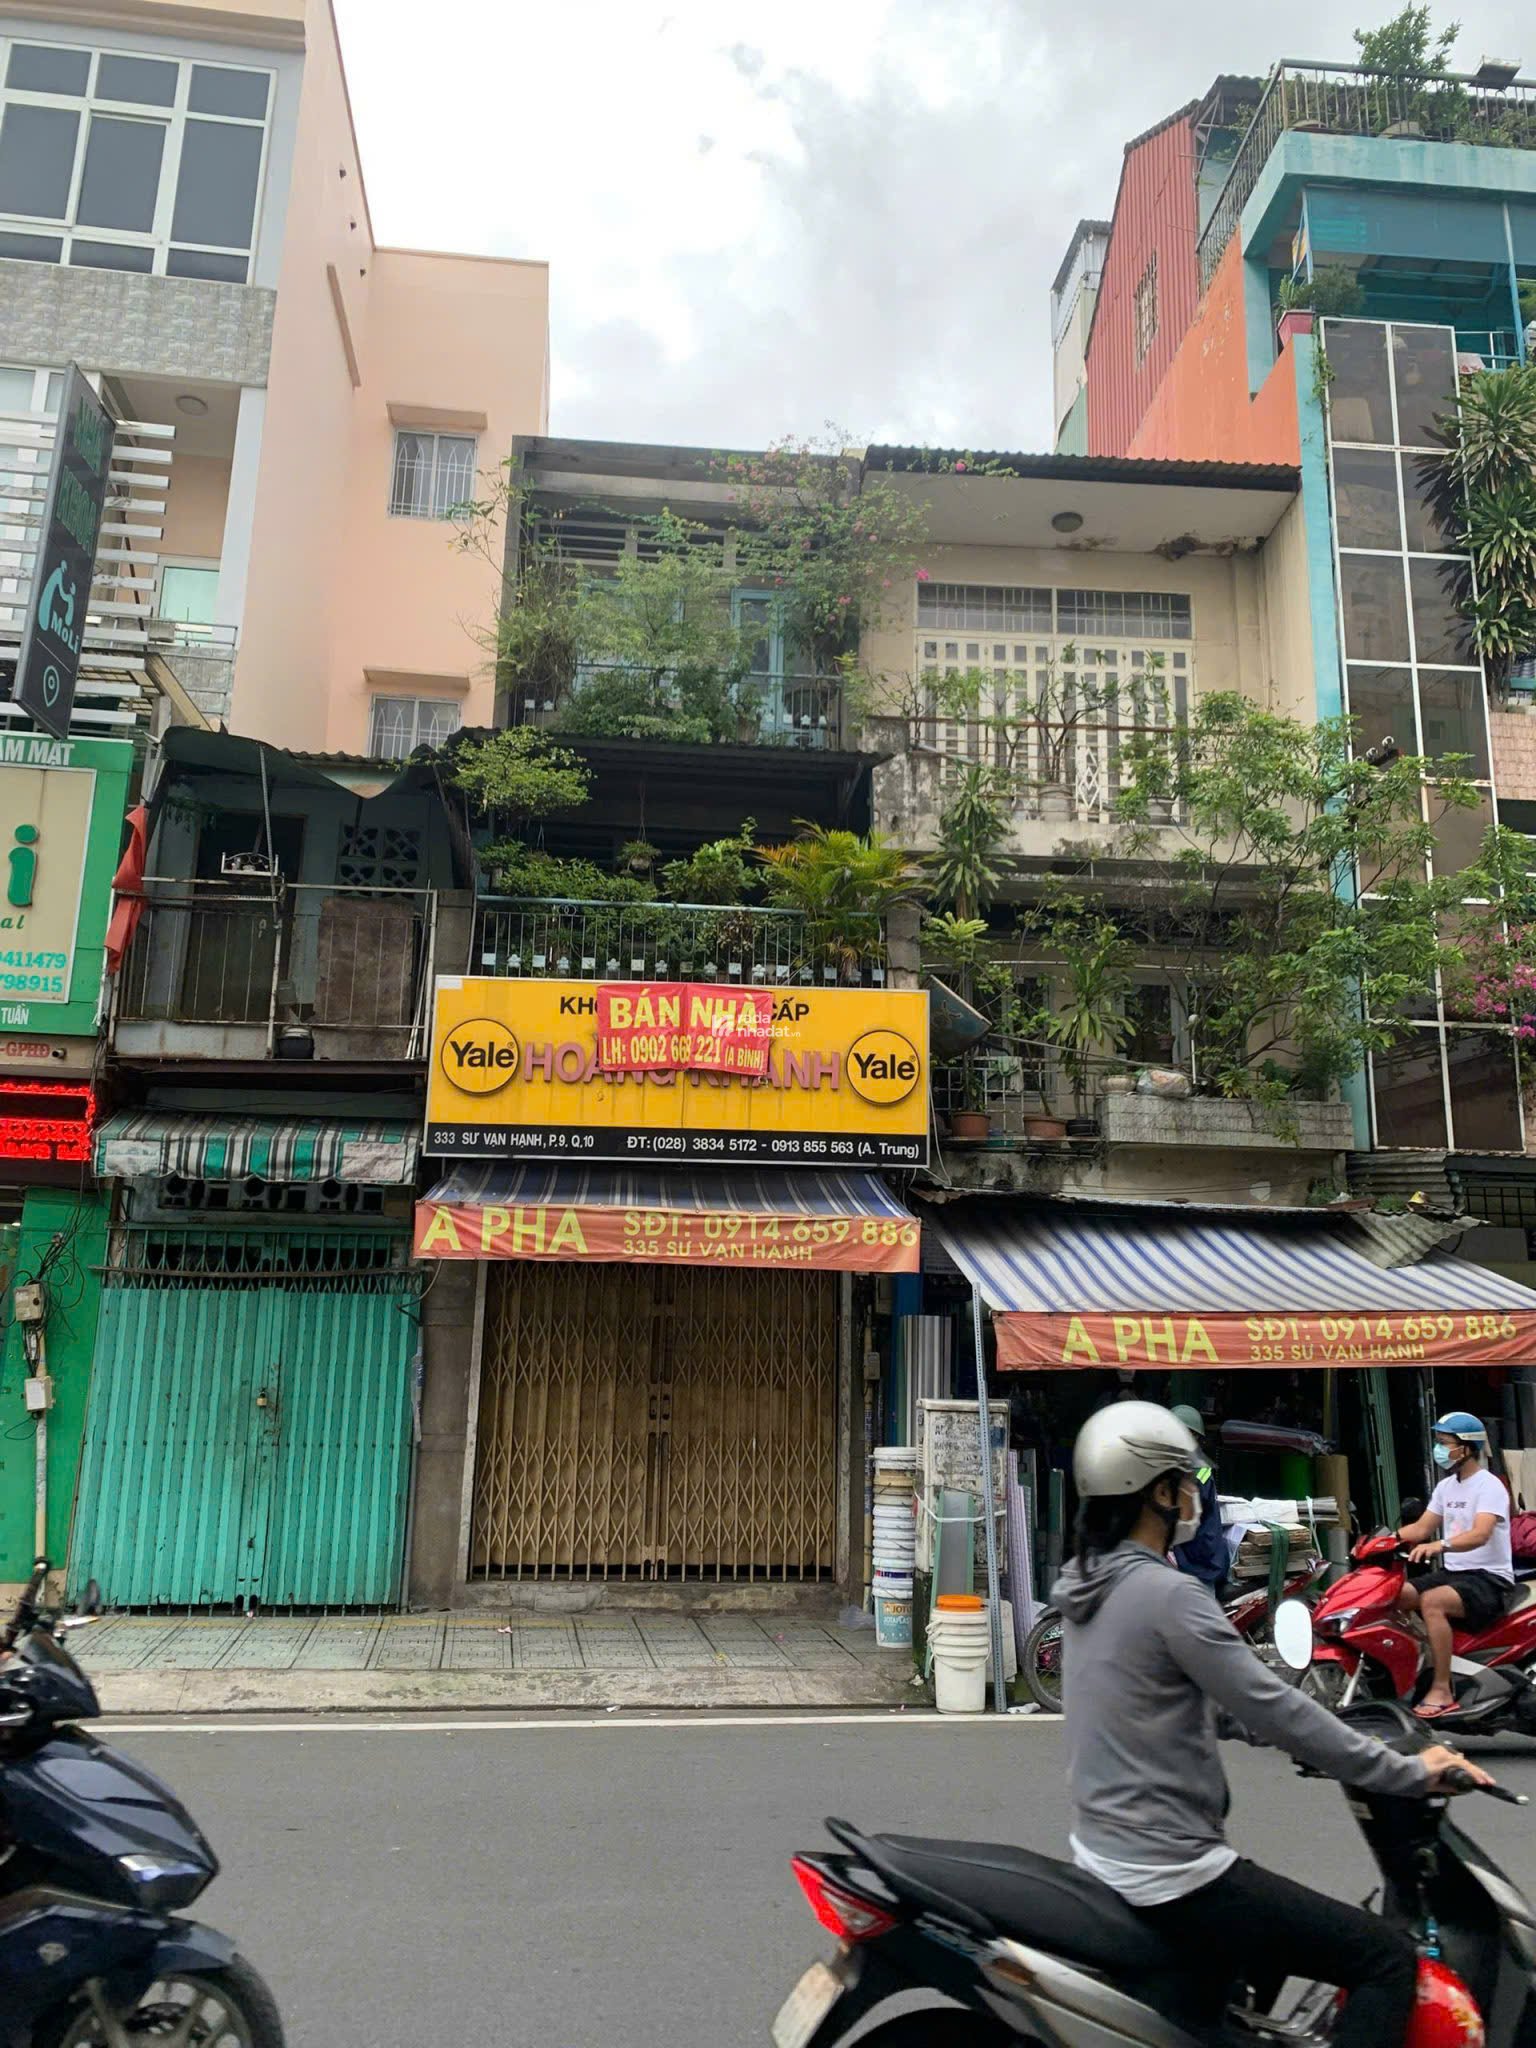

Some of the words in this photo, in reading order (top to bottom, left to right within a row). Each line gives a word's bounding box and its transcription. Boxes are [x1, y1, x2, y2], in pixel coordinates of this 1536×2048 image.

[0, 951, 67, 969] 411479
[610, 988, 680, 1029] BÁN
[690, 992, 757, 1031] NHÀ
[602, 1036, 626, 1064] LH:
[630, 1034, 667, 1063] 0902
[694, 1035, 721, 1063] 221
[434, 1132, 456, 1144] 333
[461, 1131, 480, 1145] SƯ
[483, 1132, 506, 1147] VẠN
[653, 1136, 686, 1153] (028)
[692, 1138, 725, 1150] 3834
[729, 1139, 757, 1151] 5172
[771, 1139, 800, 1152] 0913
[803, 1140, 827, 1153] 855
[830, 1141, 854, 1154] 563
[857, 1141, 876, 1157] (A.
[878, 1142, 920, 1159] Trung)
[419, 1206, 462, 1252] A
[482, 1206, 589, 1254] PHA
[623, 1211, 692, 1240] SĐT:
[703, 1213, 918, 1248] 0914.659.886
[623, 1240, 660, 1255] 335
[666, 1239, 692, 1256] SƯ
[699, 1242, 745, 1261] VẠN
[753, 1245, 813, 1264] HẠNH
[1061, 1316, 1099, 1362] A
[1113, 1317, 1220, 1363] PHA
[1244, 1316, 1311, 1342] SĐT:
[1319, 1316, 1518, 1341] 0914.659.886
[1250, 1344, 1285, 1361] 335
[1321, 1344, 1363, 1363] VẠN
